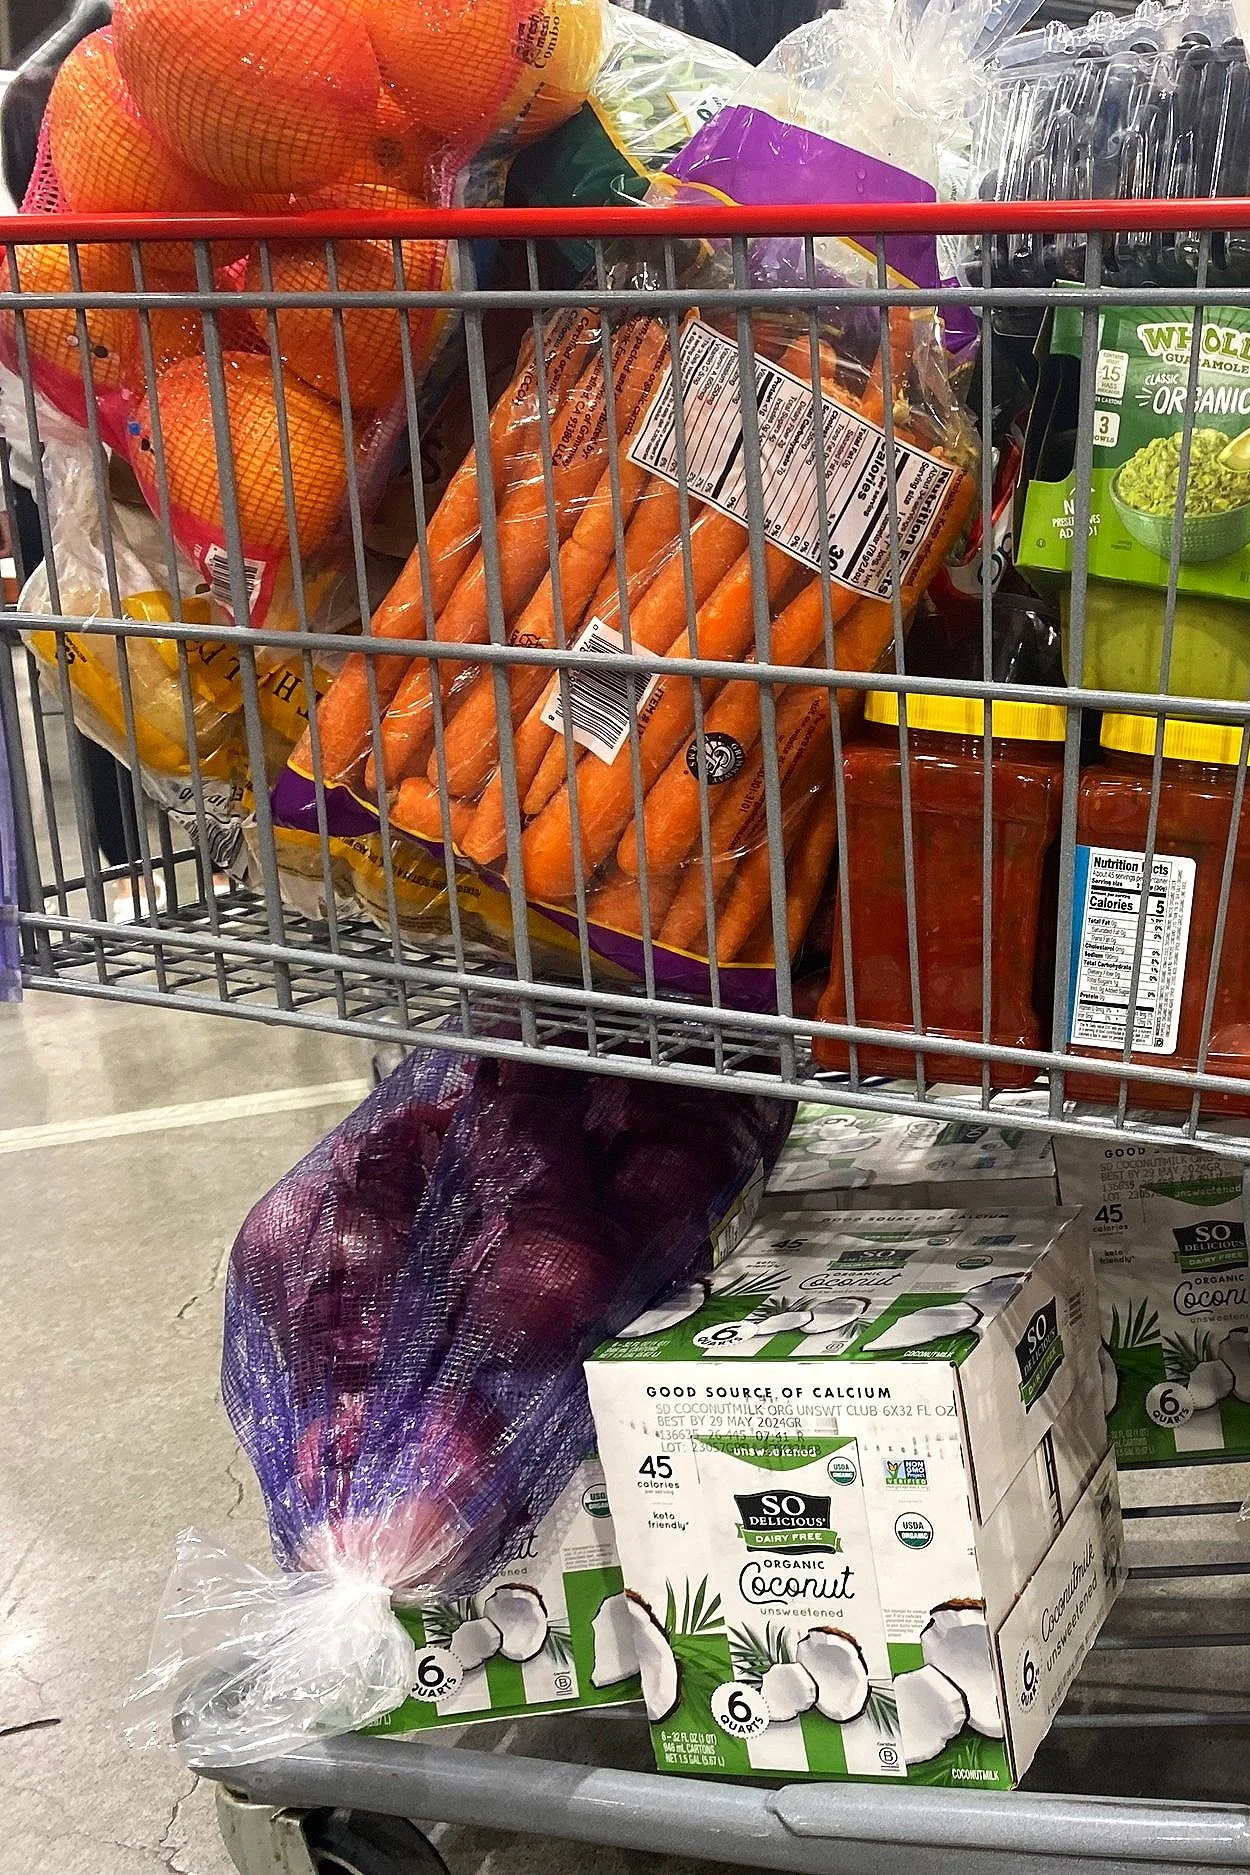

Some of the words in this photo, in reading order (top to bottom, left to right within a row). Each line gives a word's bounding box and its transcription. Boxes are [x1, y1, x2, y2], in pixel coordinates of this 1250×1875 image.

[623, 338, 645, 372] packed
[1102, 365, 1120, 382] 15
[1144, 374, 1178, 386] CLASSIC
[768, 377, 782, 402] Protein
[575, 401, 585, 415] CA
[562, 415, 578, 444] 93380
[1100, 417, 1108, 433] 3
[857, 440, 889, 501] Calories
[912, 461, 929, 491] Serving
[905, 471, 949, 545] Nutrition
[1093, 857, 1138, 872] Nutrition
[1091, 878, 1112, 886] Serving
[1089, 896, 1133, 911] Calories
[1156, 901, 1165, 914] 5
[1097, 961, 1132, 971] Carbohydrate
[1080, 992, 1099, 1000] Protein
[1104, 1147, 1145, 1158] GOOD
[1094, 1204, 1123, 1223] 45
[1195, 1225, 1231, 1242] SO
[1184, 1240, 1246, 1251] DELICIOUS
[1194, 1274, 1245, 1286] ORGANIC
[647, 1387, 696, 1397] GOOD
[706, 1387, 772, 1398] SOURCE
[782, 1387, 802, 1398] OF
[813, 1388, 891, 1398] CALCIUM
[1159, 1388, 1180, 1416] 6
[674, 1404, 762, 1415] COCONUTMILK
[768, 1405, 793, 1415] ORG
[847, 1405, 878, 1416] CLUB
[883, 1406, 912, 1416] 6X32
[917, 1405, 931, 1416] FL
[1152, 1407, 1190, 1425] QUARTS
[658, 1416, 685, 1426] BEST
[690, 1416, 705, 1426] BY
[710, 1416, 723, 1426] 29
[727, 1416, 752, 1427] MAY
[758, 1417, 802, 1428] 2024GR
[661, 1442, 686, 1453] LOT:
[639, 1455, 673, 1479] 45
[637, 1479, 680, 1489] calories
[761, 1496, 806, 1516] SO
[653, 1512, 675, 1521] keto
[903, 1521, 924, 1530] USDA
[756, 1533, 789, 1544] DAIRY
[792, 1532, 823, 1542] FREE
[764, 1560, 825, 1570] ORGANIC
[739, 1562, 855, 1605] Coconut
[760, 1608, 844, 1618] unsweetened
[417, 1655, 444, 1687] 6
[728, 1691, 752, 1722] 6
[721, 1714, 764, 1734] QUARTS
[665, 1753, 678, 1763] NET
[952, 1768, 999, 1781] COCONUTMILK
